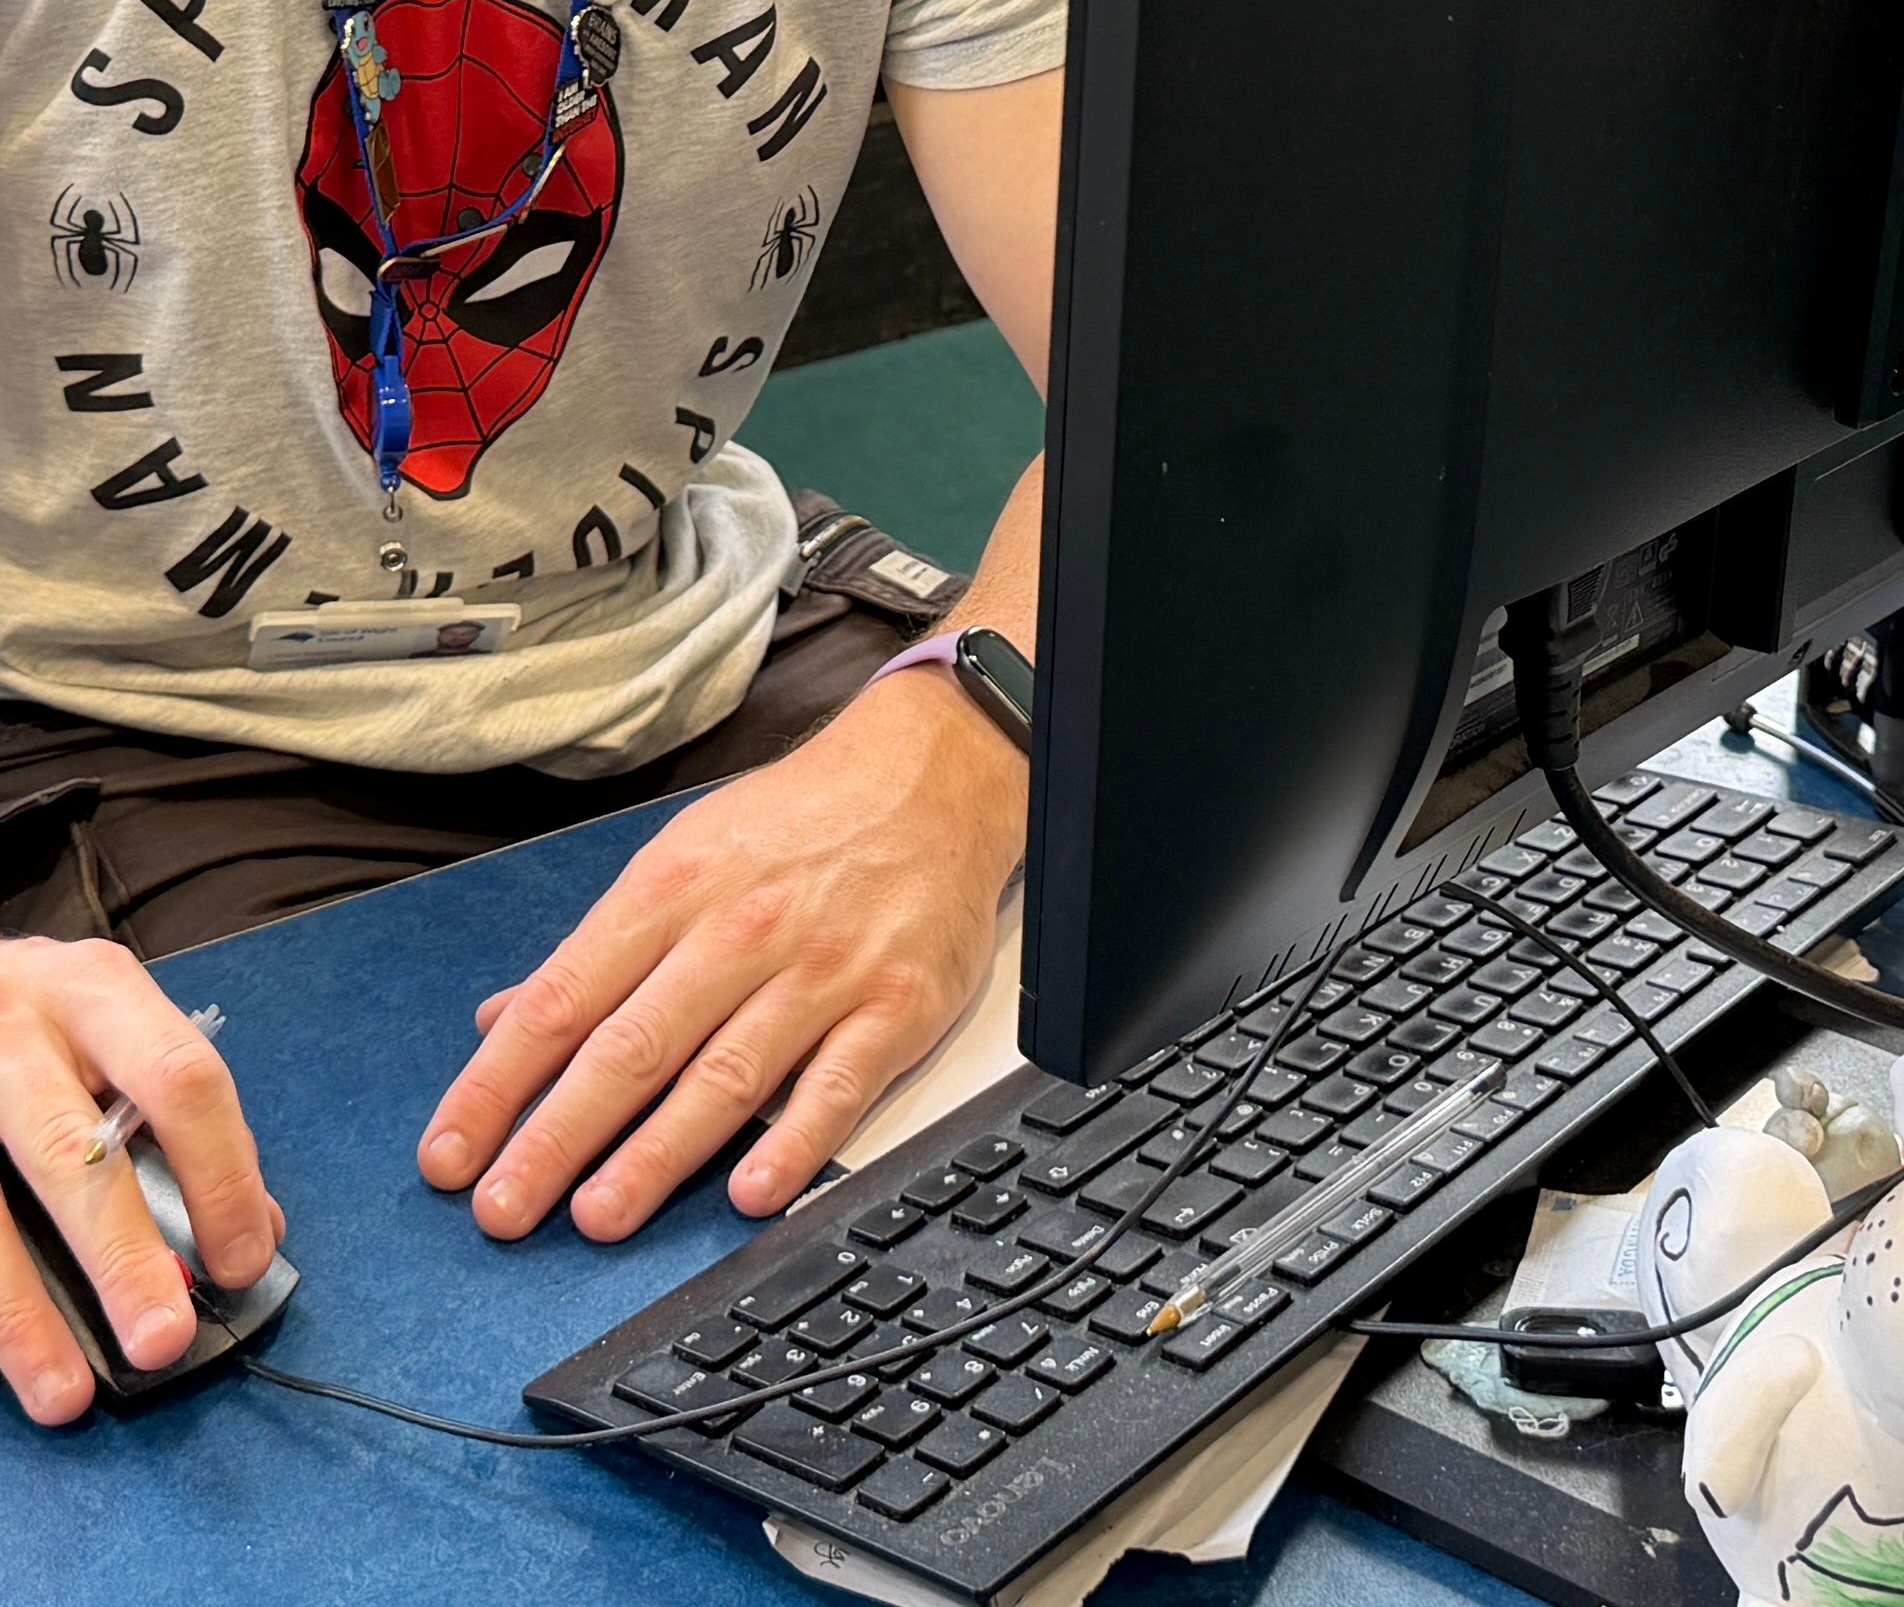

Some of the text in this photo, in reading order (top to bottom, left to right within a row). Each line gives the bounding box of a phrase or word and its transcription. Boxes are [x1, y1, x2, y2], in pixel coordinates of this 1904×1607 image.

[1071, 1224, 1105, 1248] Delete
[1136, 1300, 1160, 1321] End
[1242, 1286, 1278, 1315] Pause
[1199, 1322, 1231, 1348] Insert
[672, 1371, 707, 1397] Enter
[939, 1457, 1073, 1546] Lenovo
